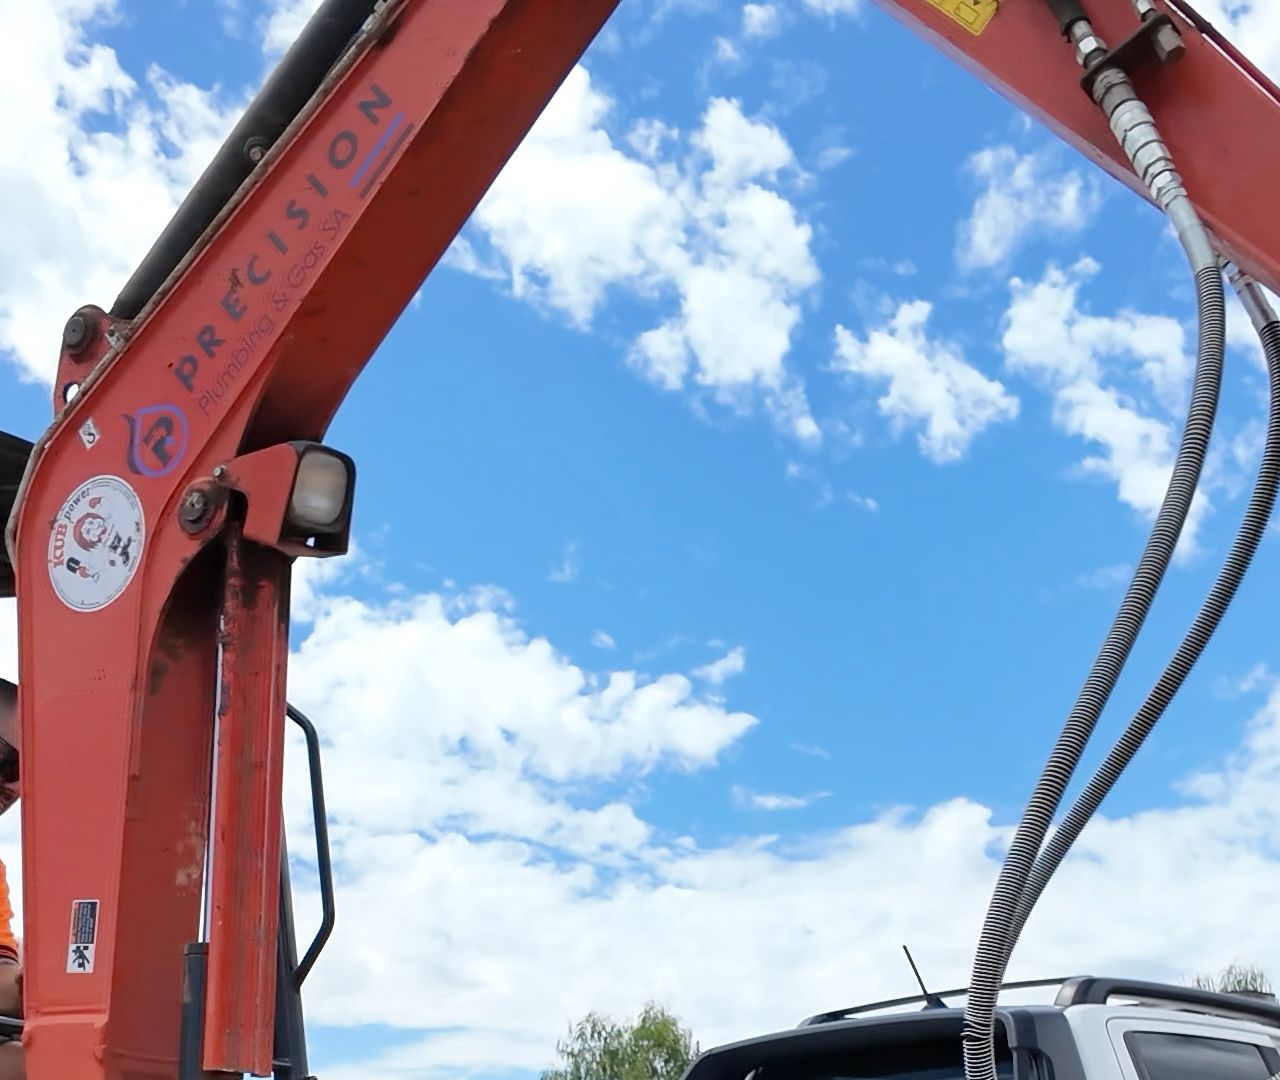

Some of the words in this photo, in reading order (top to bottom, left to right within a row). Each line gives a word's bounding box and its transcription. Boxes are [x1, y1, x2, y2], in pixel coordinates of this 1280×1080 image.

[174, 84, 391, 392] PRECISION
[198, 313, 274, 416] Plumbing
[272, 288, 289, 311] &
[288, 241, 324, 289] Gas
[323, 208, 351, 240] SA
[64, 487, 91, 524] power
